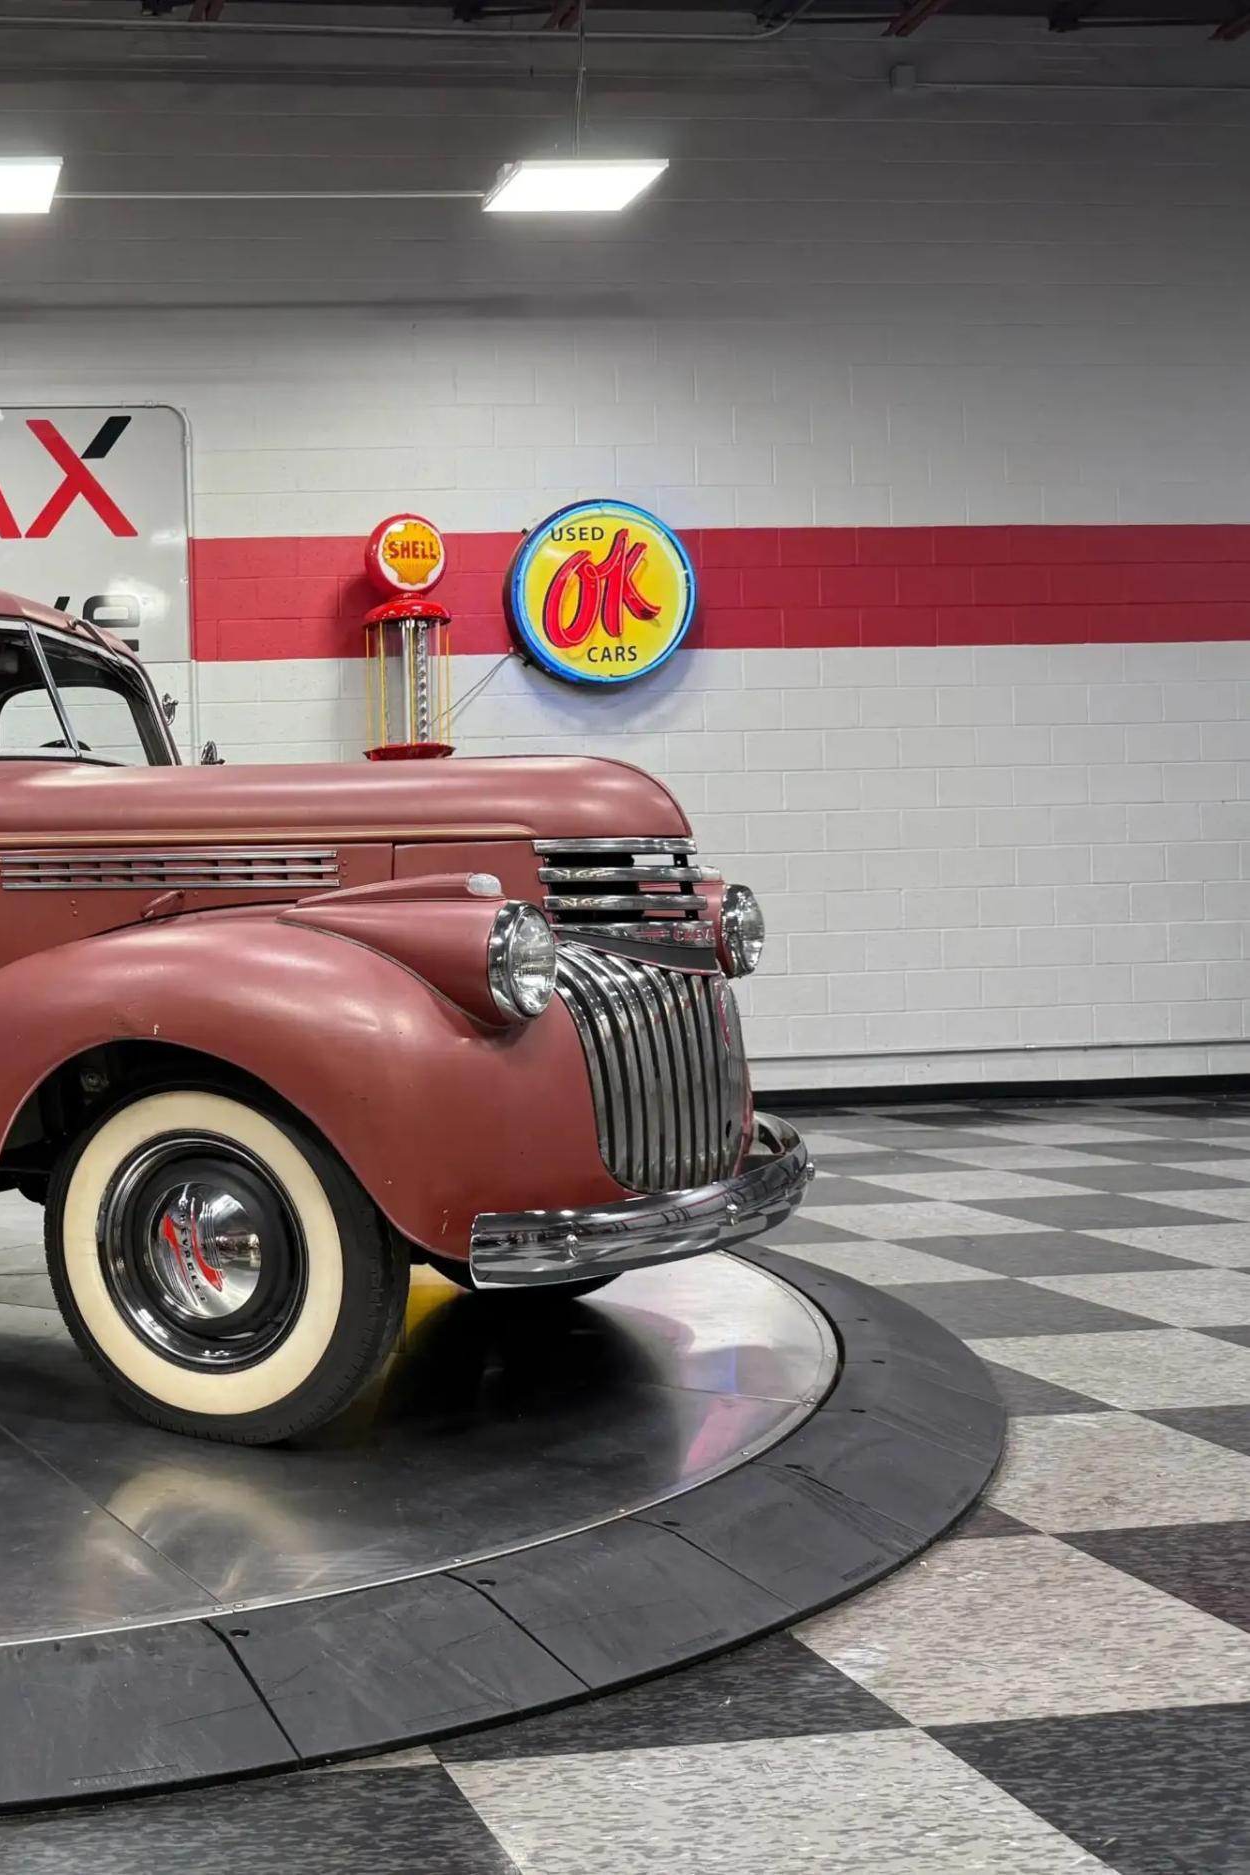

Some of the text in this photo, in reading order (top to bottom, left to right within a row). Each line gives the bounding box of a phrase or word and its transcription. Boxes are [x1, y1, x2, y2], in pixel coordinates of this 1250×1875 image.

[551, 527, 604, 542] USED
[387, 541, 437, 560] SHELL
[542, 528, 662, 649] OK
[587, 646, 637, 662] CARS
[672, 926, 714, 942] CHEV
